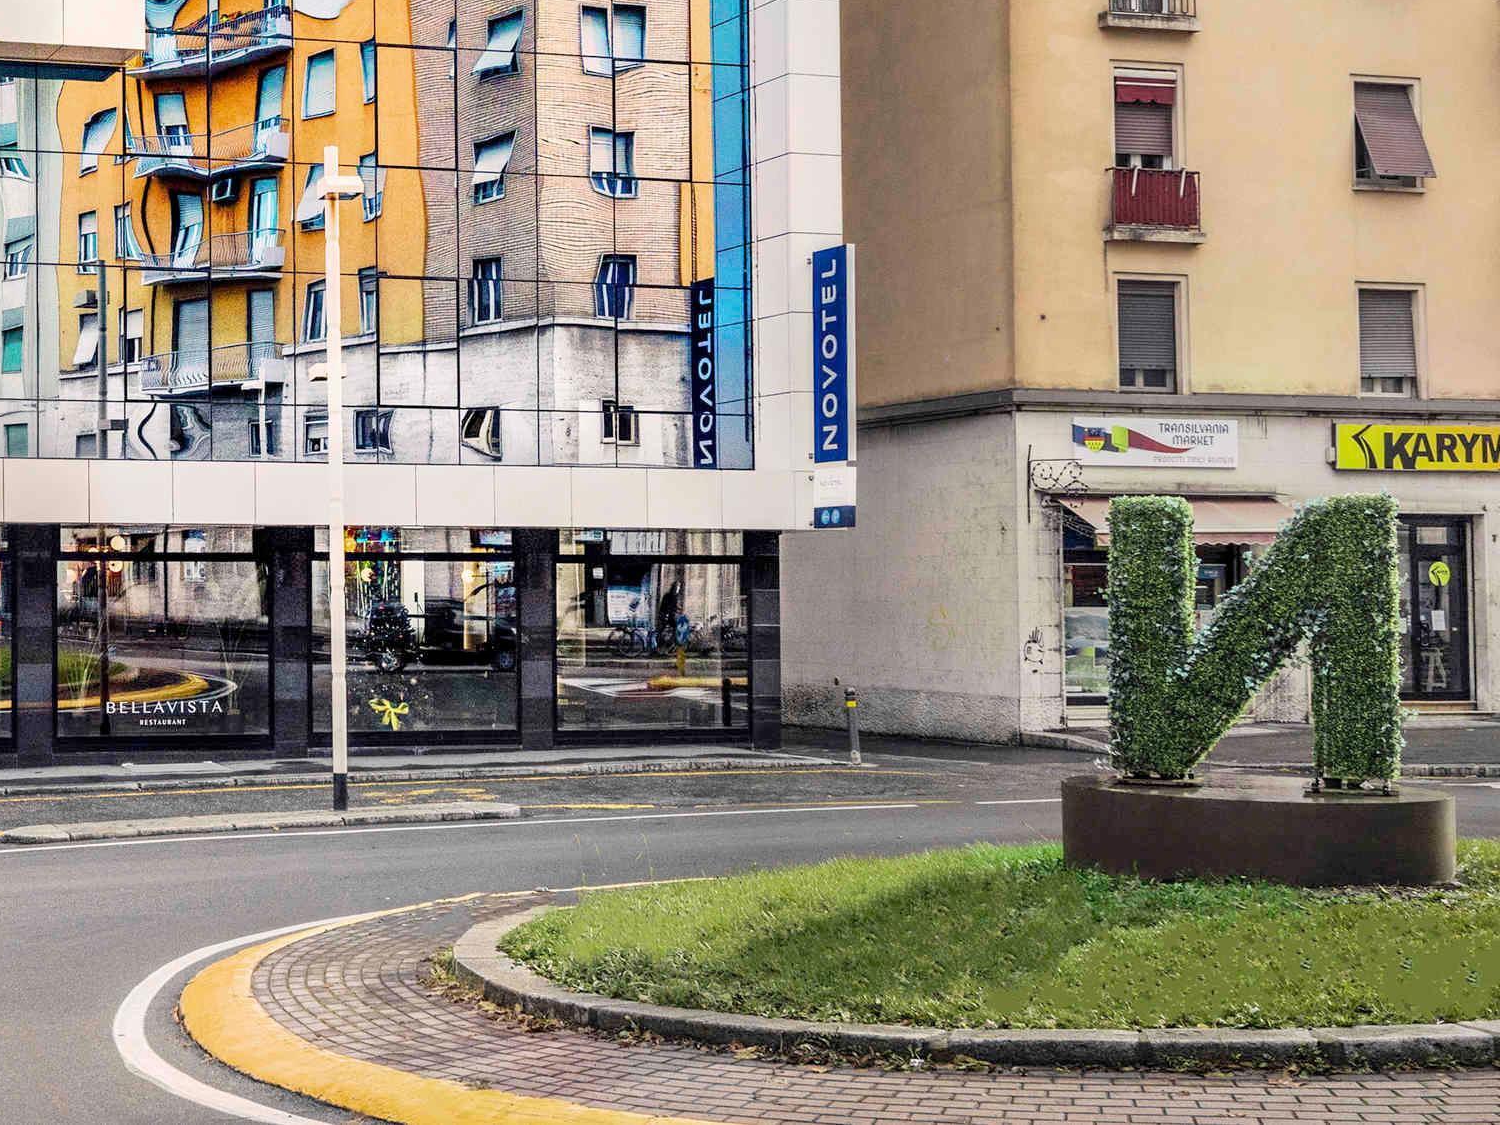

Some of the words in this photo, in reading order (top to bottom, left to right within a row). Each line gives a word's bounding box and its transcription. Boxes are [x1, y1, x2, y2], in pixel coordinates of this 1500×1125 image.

[820, 258, 838, 451] NOVOTEL
[1158, 422, 1229, 435] TRANSILVANIA
[1172, 435, 1215, 446] MARKET
[106, 700, 223, 714] BELLAVISTA
